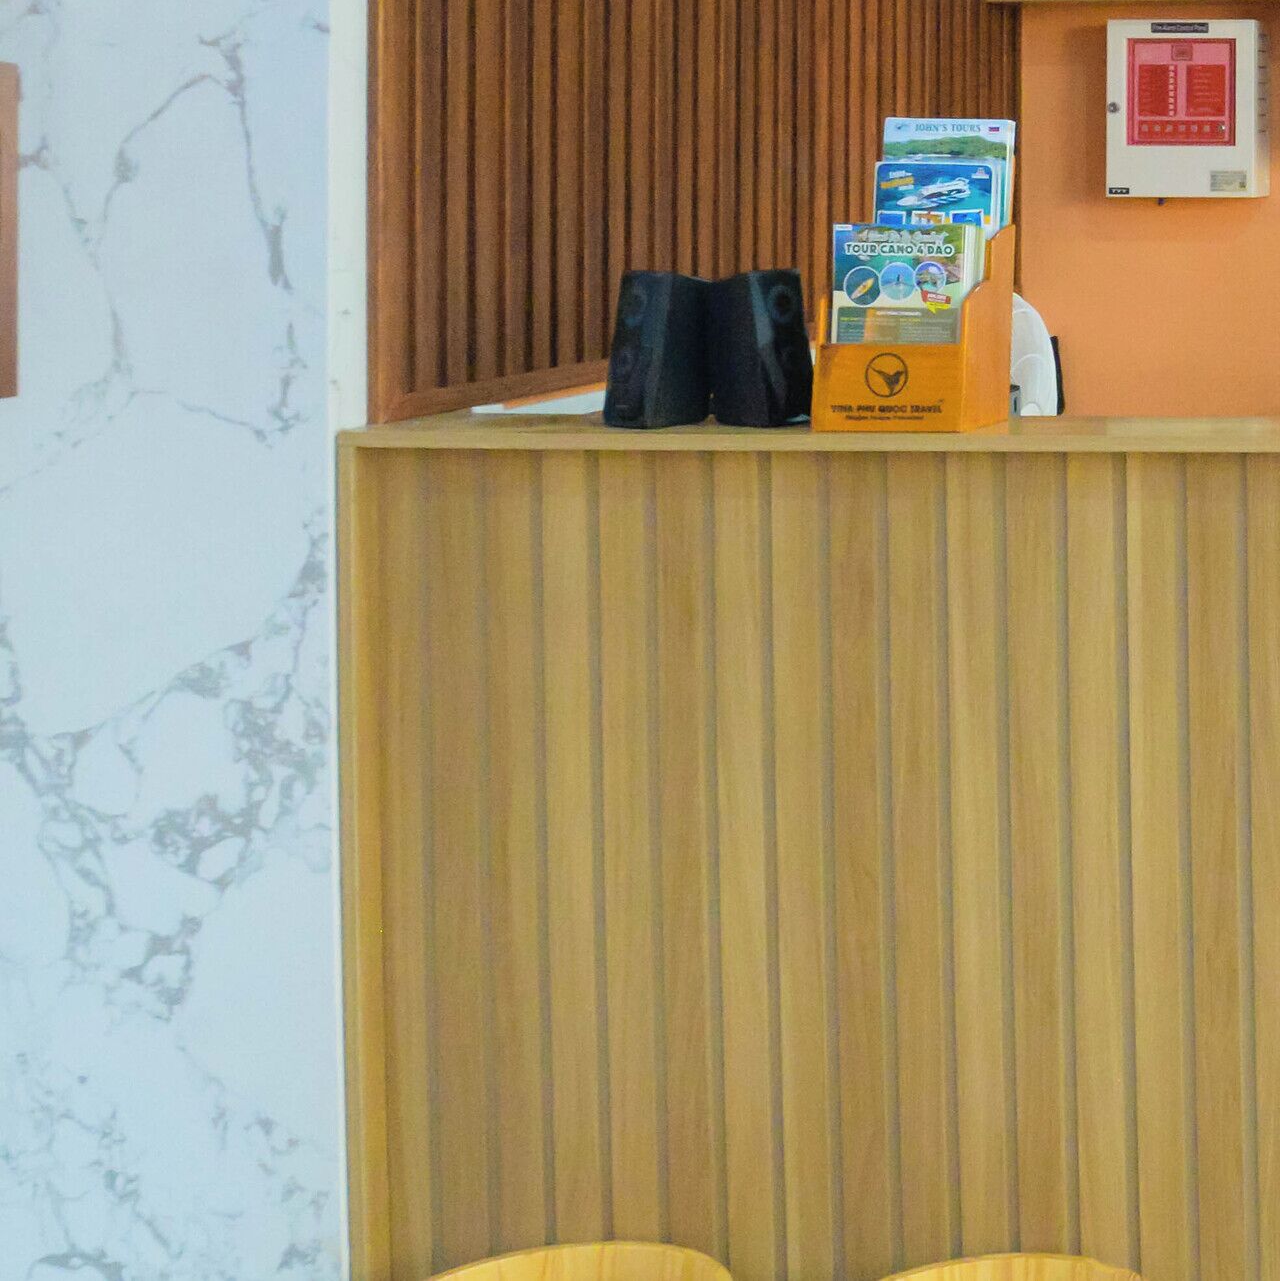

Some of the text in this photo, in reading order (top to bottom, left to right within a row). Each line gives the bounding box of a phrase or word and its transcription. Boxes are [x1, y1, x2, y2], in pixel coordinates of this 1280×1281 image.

[915, 123, 981, 133] JOHN'S TOURS
[846, 243, 877, 255] TOUR
[880, 243, 914, 255] CANO
[916, 244, 924, 255] 4
